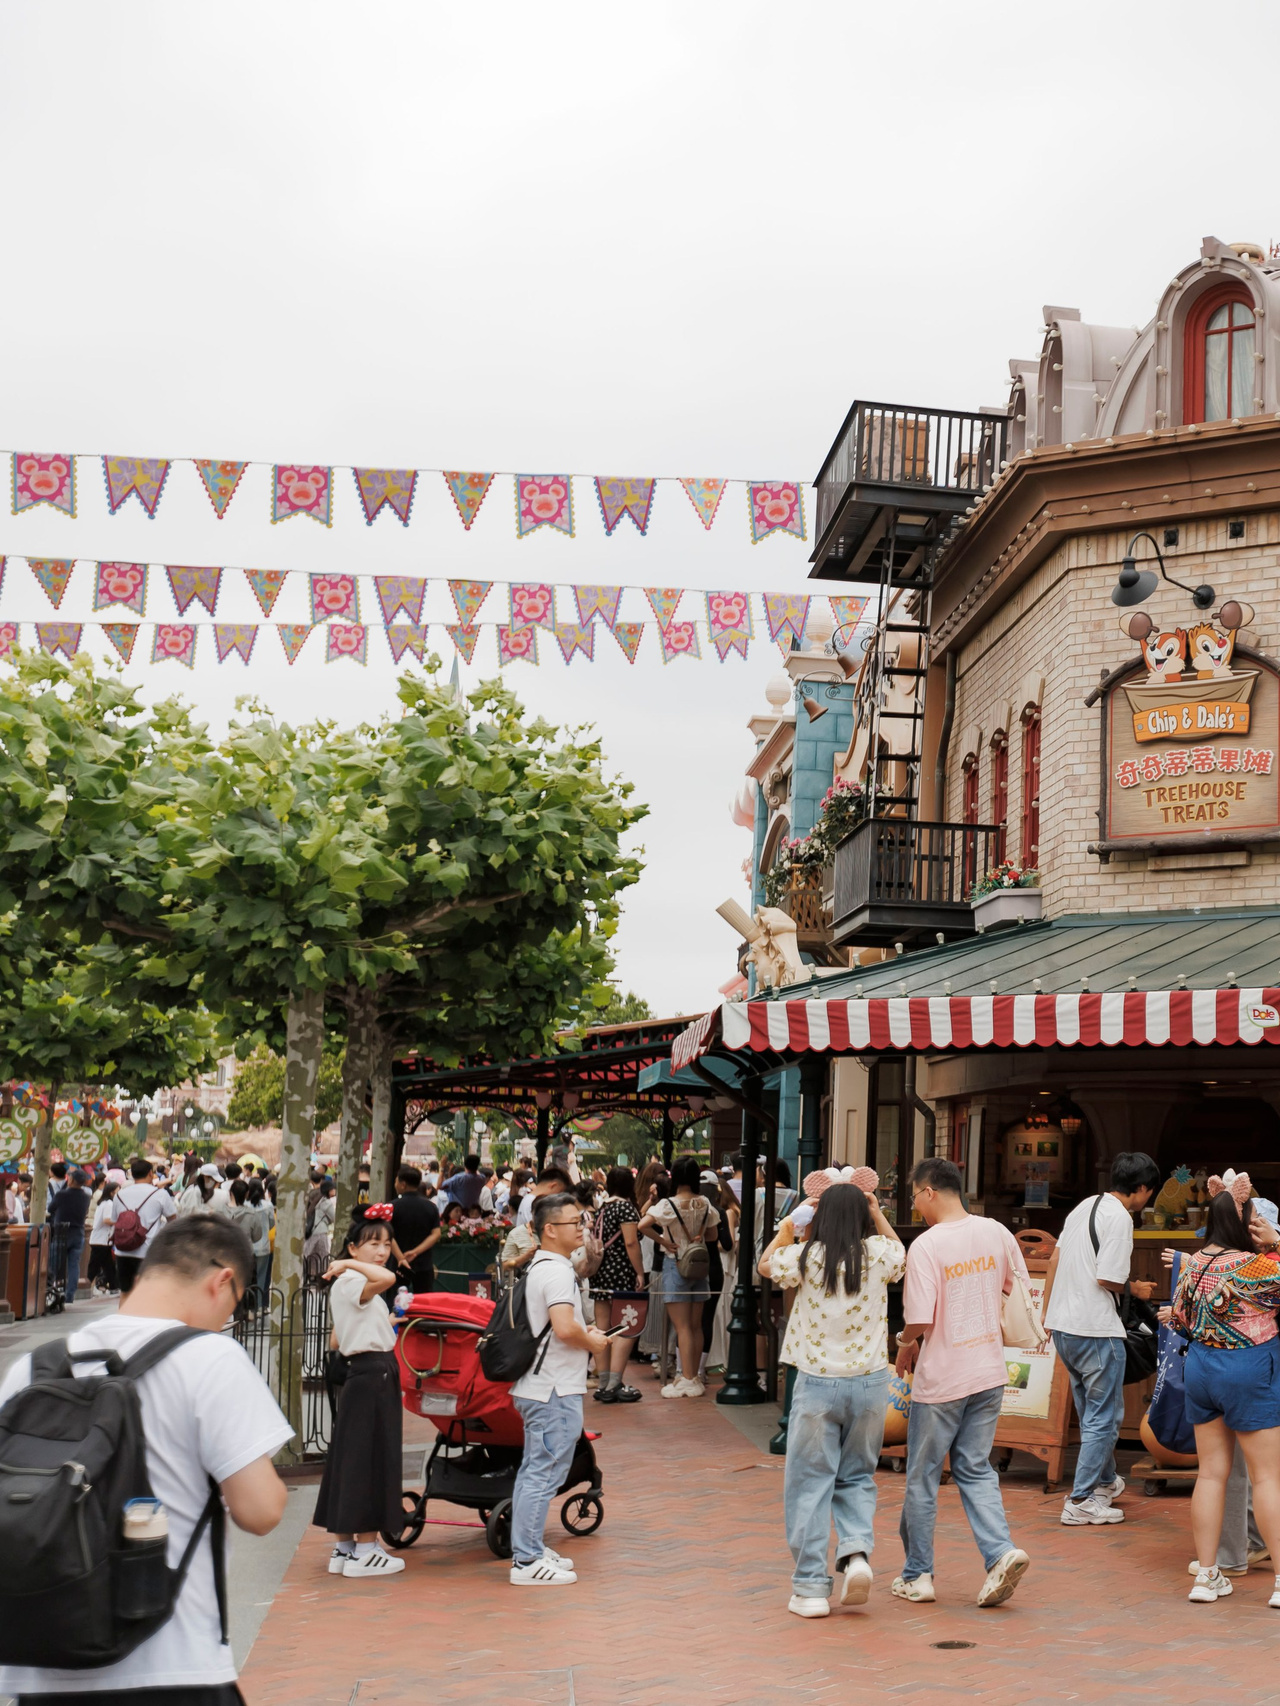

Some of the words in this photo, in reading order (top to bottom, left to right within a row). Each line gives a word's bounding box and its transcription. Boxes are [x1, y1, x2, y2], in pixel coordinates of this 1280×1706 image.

[1148, 710, 1177, 734] Chip
[1182, 707, 1193, 729] &
[1197, 705, 1235, 729] Dale's
[1115, 746, 1273, 788] 奇奇蒂蒂果摊
[1142, 781, 1247, 807] TREEHOUSE
[1160, 801, 1229, 823] TREATS
[1252, 1009, 1275, 1019] Dole
